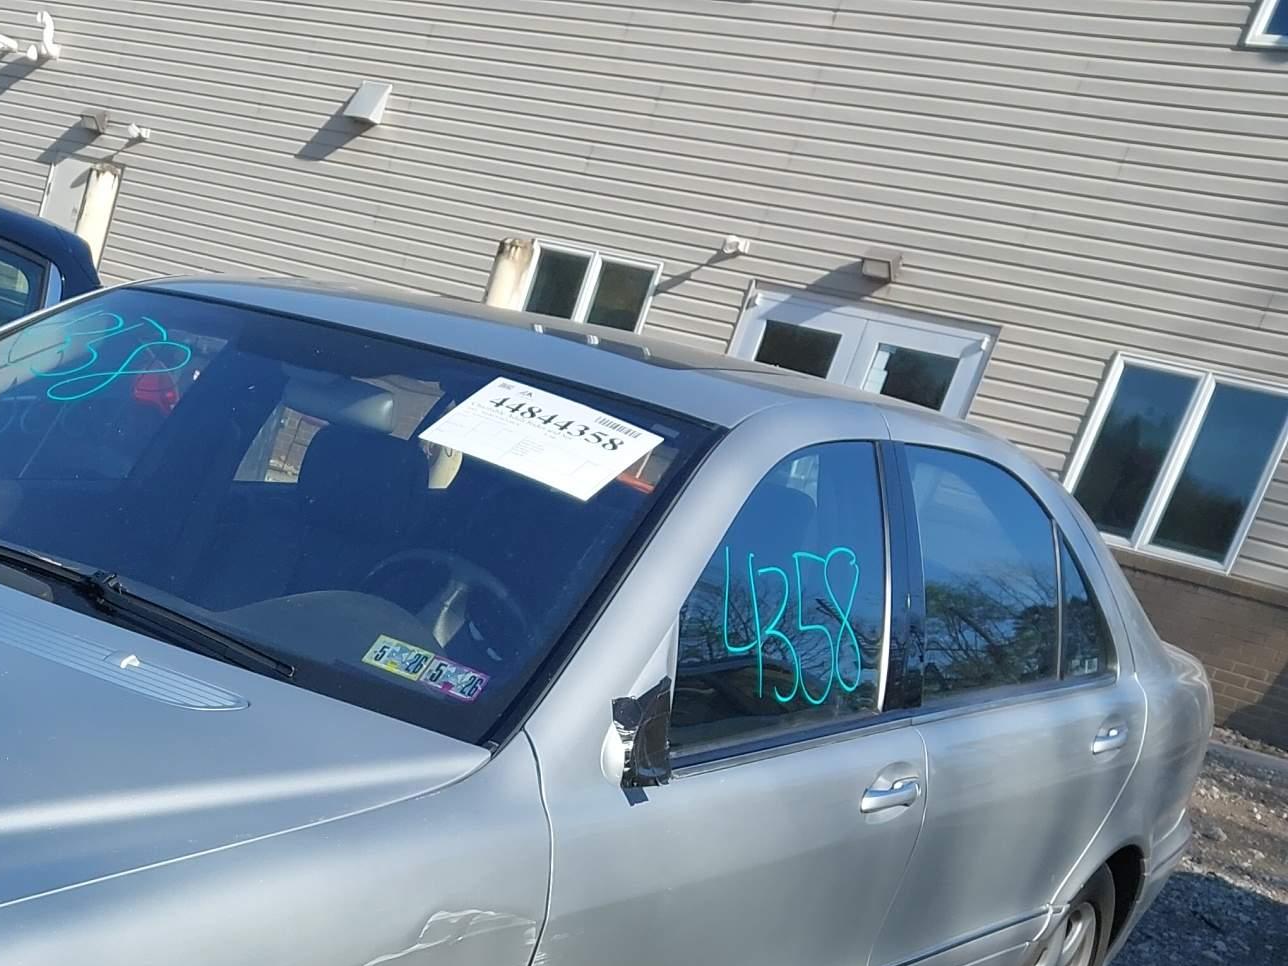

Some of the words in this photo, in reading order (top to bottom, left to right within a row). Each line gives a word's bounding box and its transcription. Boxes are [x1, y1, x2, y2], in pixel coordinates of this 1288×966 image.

[489, 396, 625, 452] 44844358
[723, 545, 862, 705] 4358
[373, 644, 392, 662] 5
[404, 652, 430, 675] 26
[428, 662, 449, 683] 5
[459, 674, 485, 698] 26
